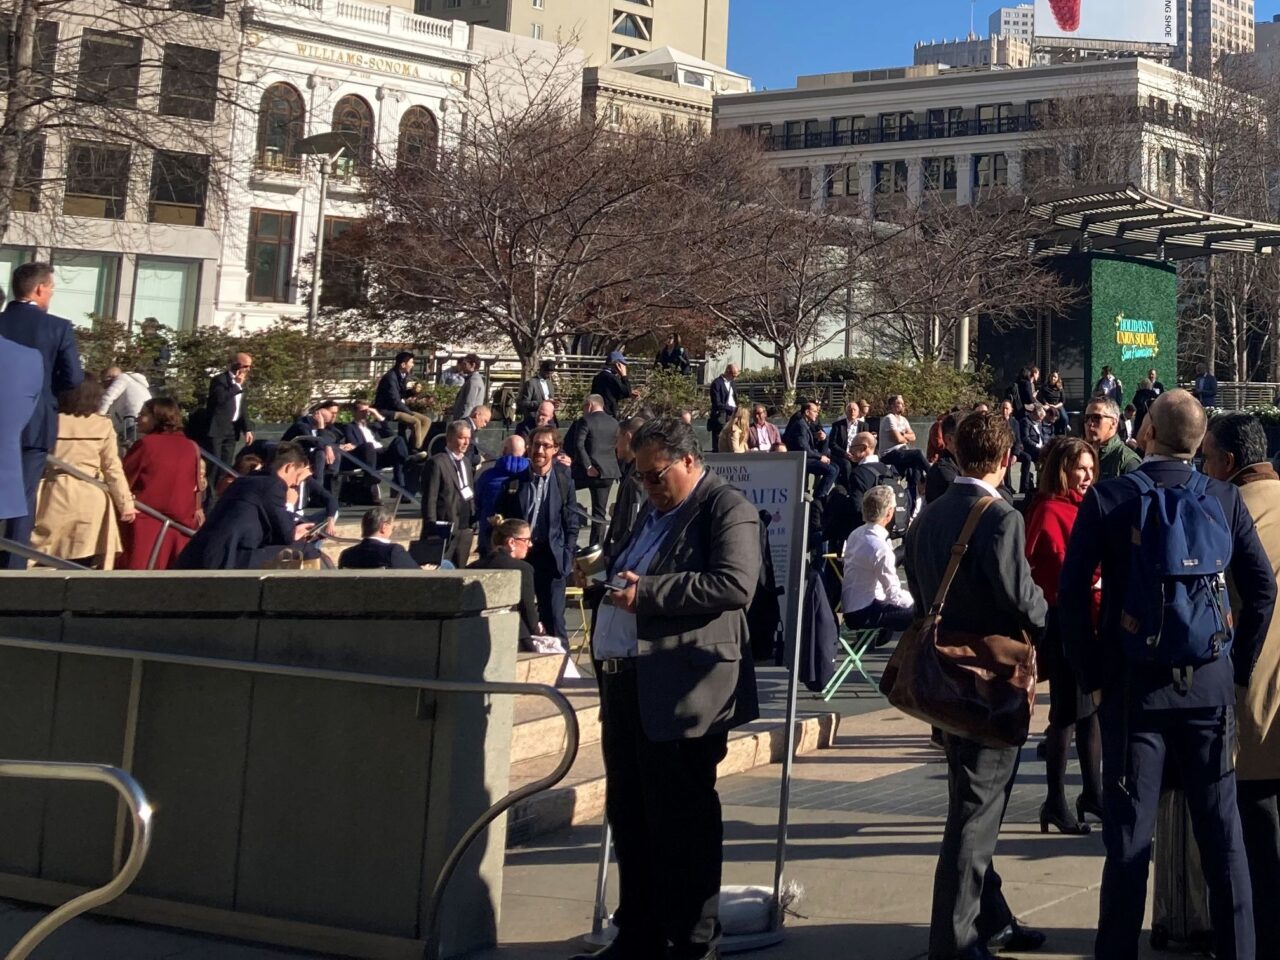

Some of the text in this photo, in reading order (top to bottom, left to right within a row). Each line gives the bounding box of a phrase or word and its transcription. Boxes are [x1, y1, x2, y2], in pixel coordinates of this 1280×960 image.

[1164, 15, 1172, 38] SHOE
[296, 42, 420, 78] WILLIAMS-SONOMA
[1120, 319, 1147, 332] HOLIDAYS
[1117, 330, 1157, 347] UNION SQUARE
